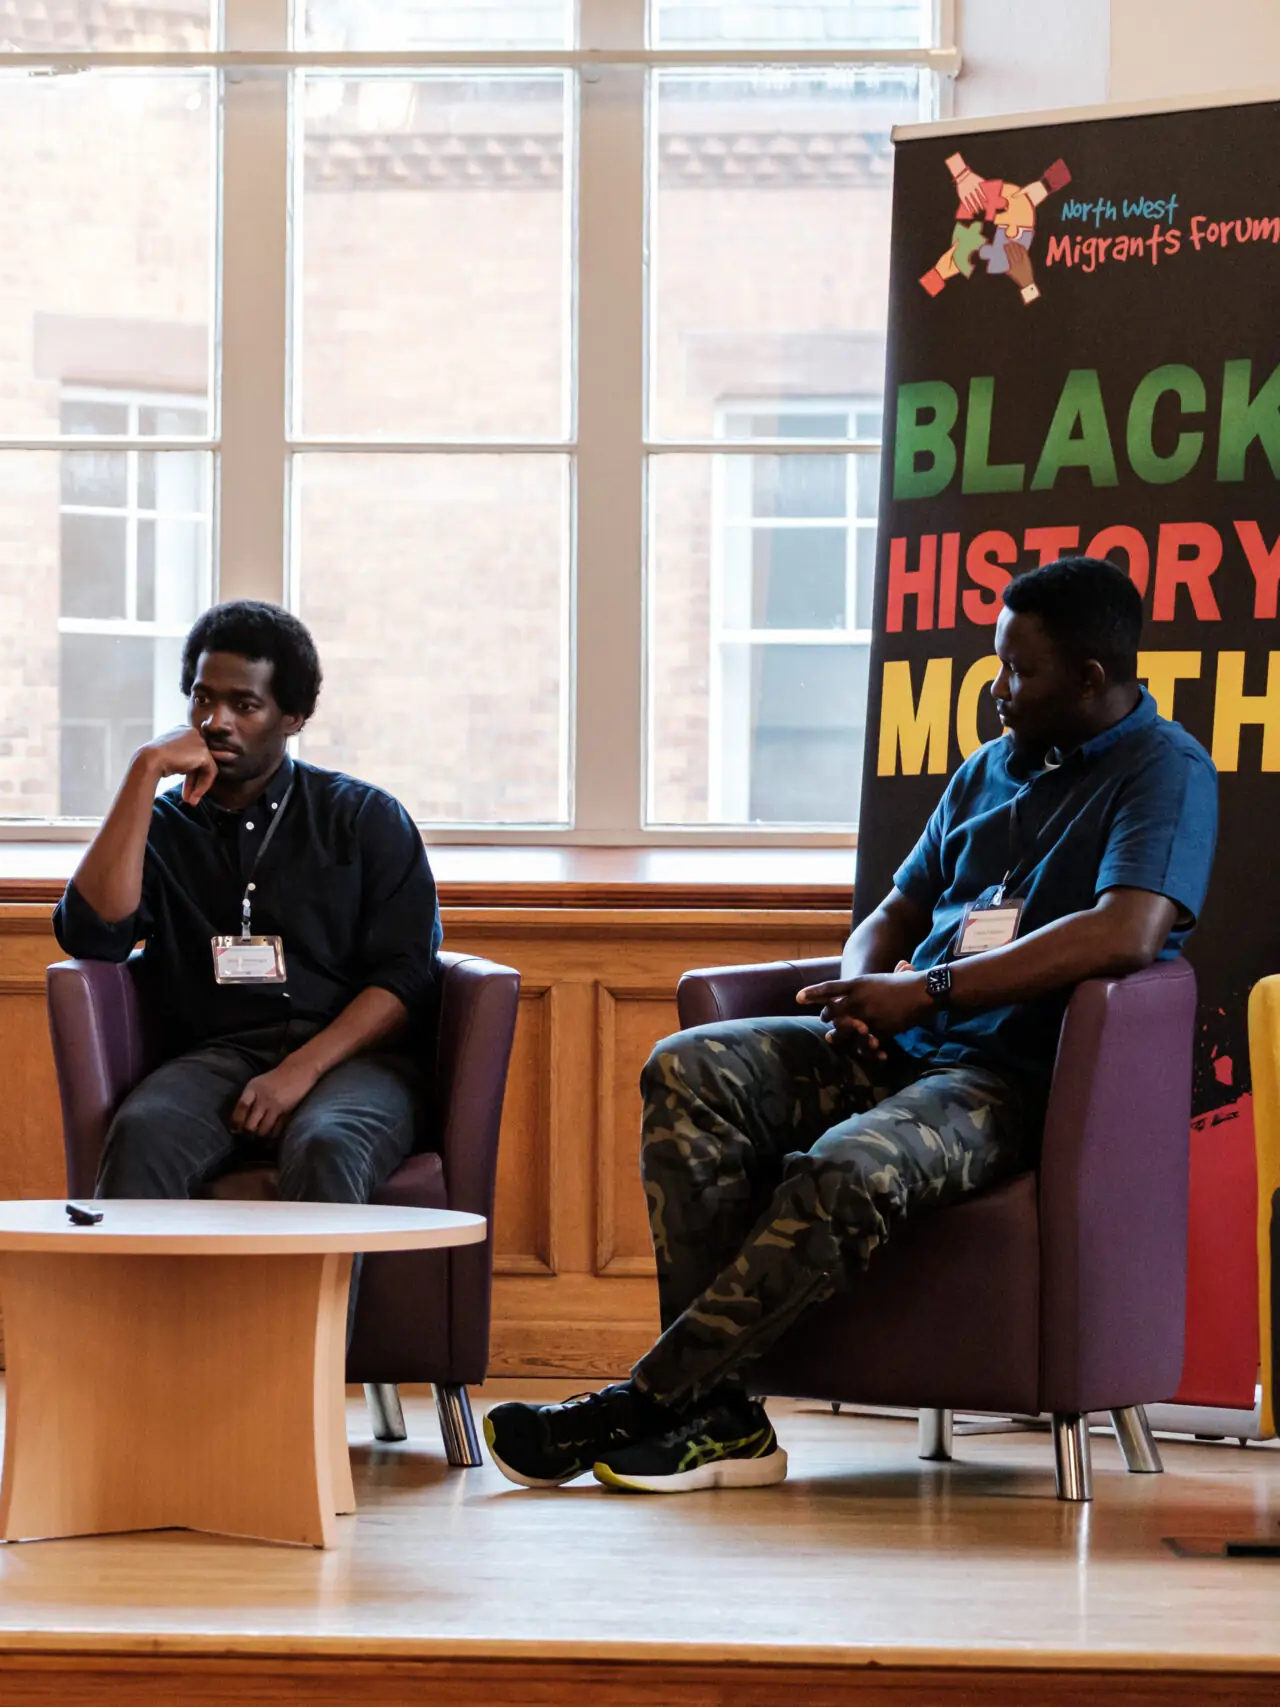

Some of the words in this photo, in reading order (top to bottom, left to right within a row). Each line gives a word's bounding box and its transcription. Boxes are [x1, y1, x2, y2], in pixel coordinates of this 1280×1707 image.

[1045, 223, 1182, 273] Migrants
[1189, 215, 1280, 250] Forum
[1061, 197, 1117, 228] North
[1122, 193, 1179, 225] West
[893, 358, 1280, 500] BLACK
[877, 650, 1280, 777] MOTH
